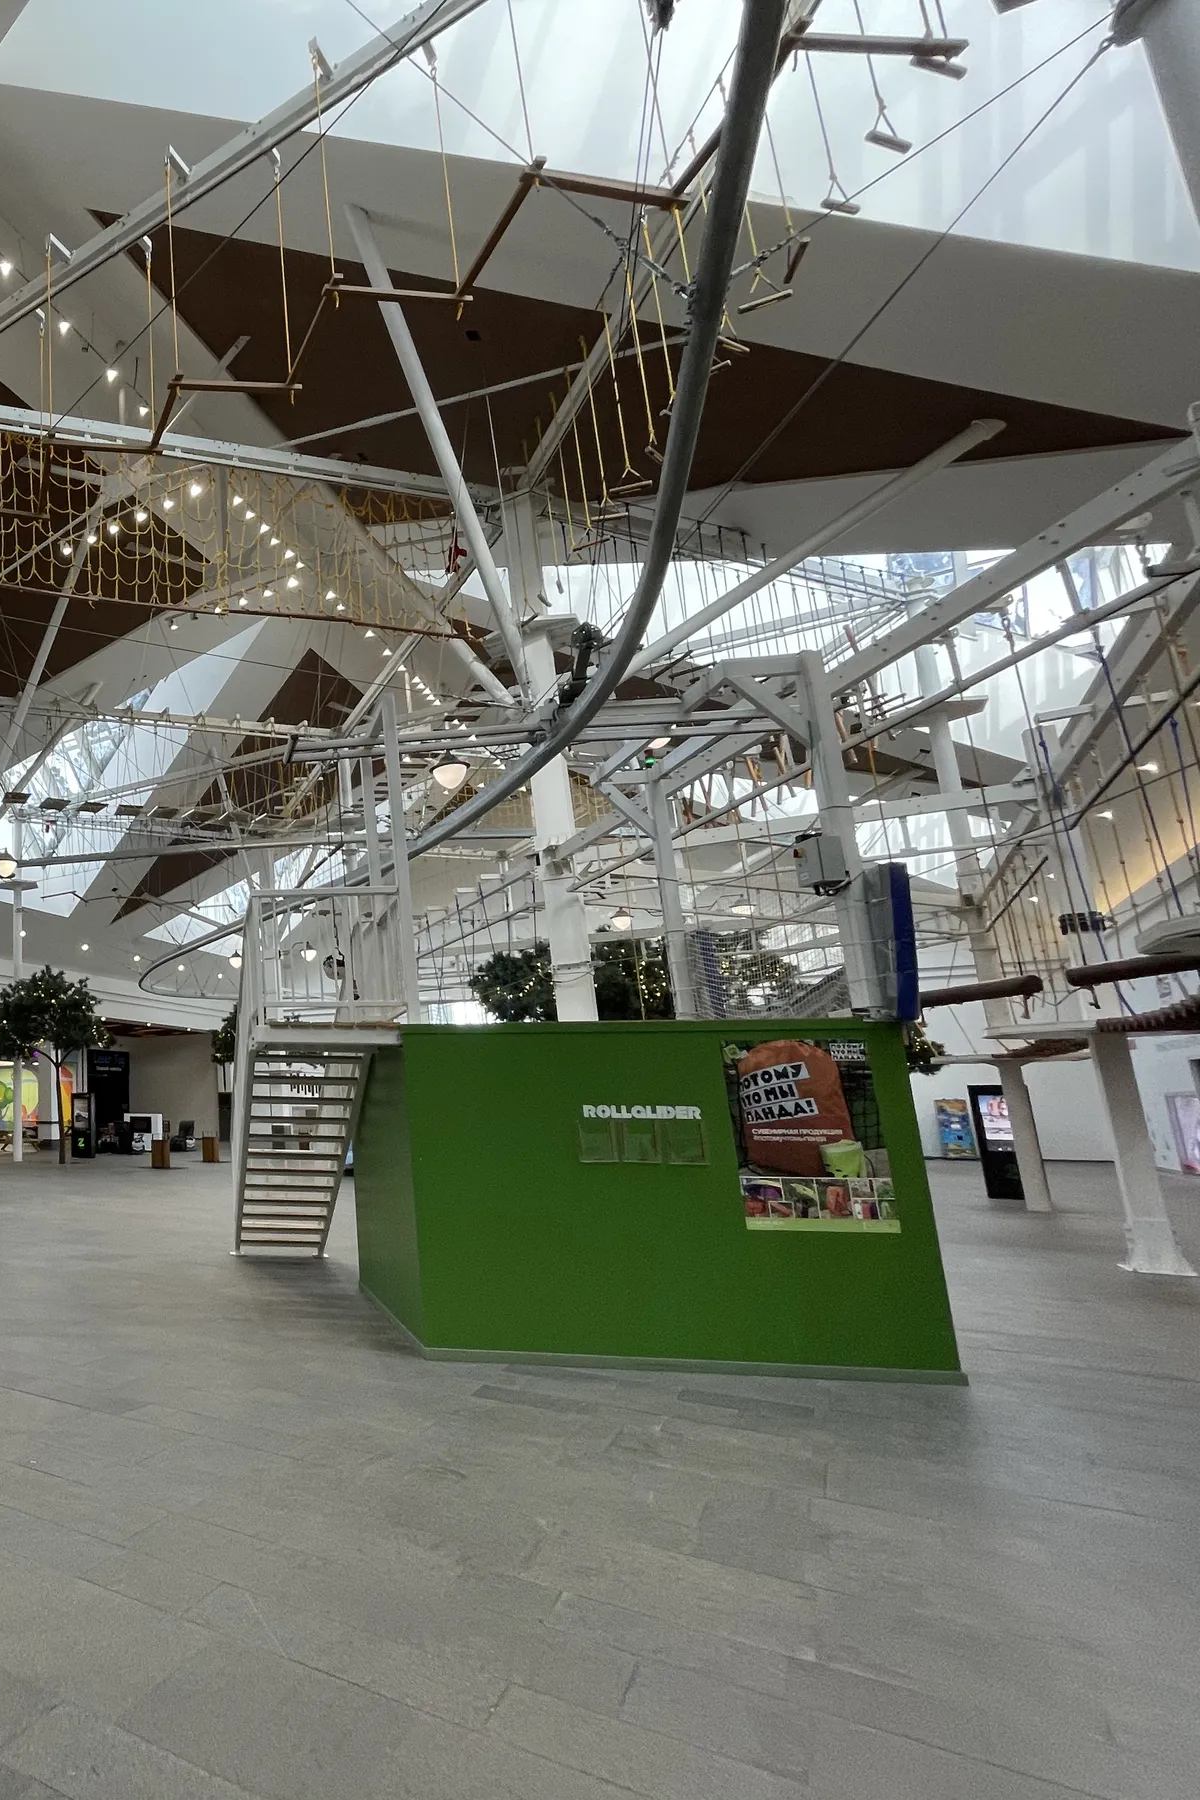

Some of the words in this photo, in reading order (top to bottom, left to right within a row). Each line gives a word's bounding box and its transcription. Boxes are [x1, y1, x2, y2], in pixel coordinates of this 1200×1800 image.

[764, 1085, 796, 1102] МЫ
[582, 1104, 702, 1120] ROLLGLIDER
[746, 1100, 815, 1122] ПАНДА!
